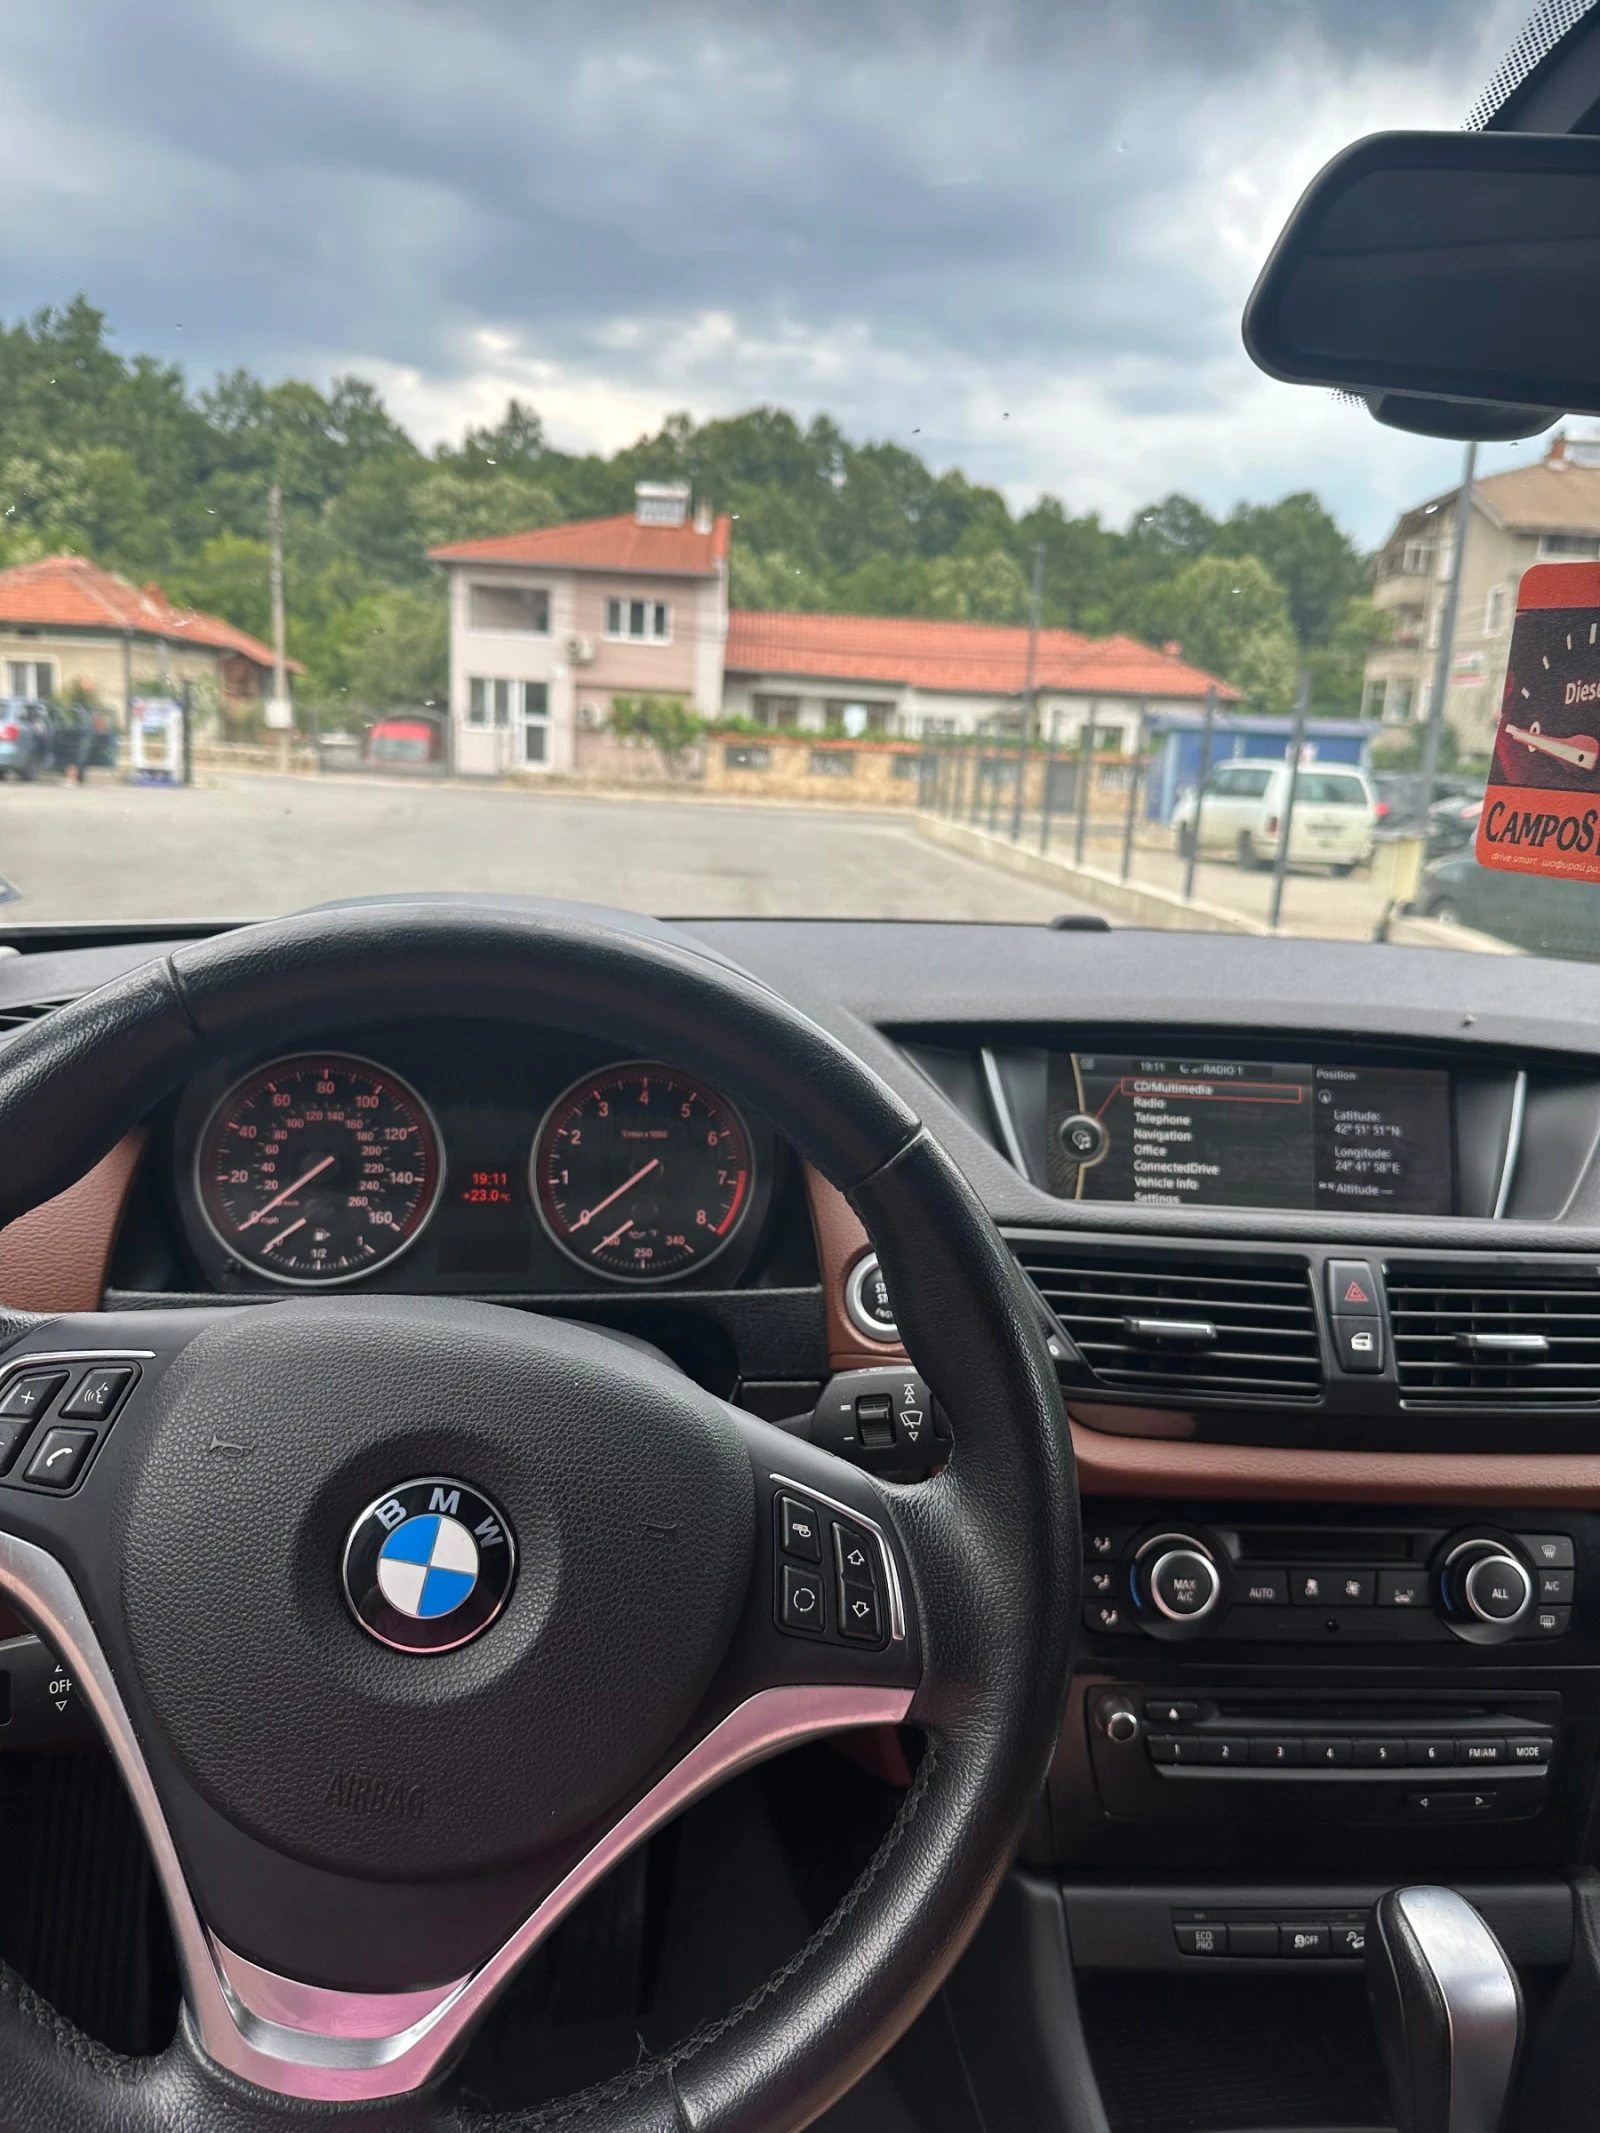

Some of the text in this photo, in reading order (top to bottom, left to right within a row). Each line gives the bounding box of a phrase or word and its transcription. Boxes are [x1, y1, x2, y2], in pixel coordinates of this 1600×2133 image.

[1486, 801, 1600, 856] CAMPOS
[1491, 852, 1537, 864] drive smart
[1140, 1061, 1165, 1072] 19:11
[1203, 1065, 1235, 1075] RADIO
[1316, 1069, 1356, 1080] Position
[316, 1081, 335, 1094] 80
[1133, 1080, 1213, 1096] CD/Multimedia
[273, 1094, 291, 1107] 60
[356, 1096, 379, 1108] 100
[640, 1091, 649, 1105] 4
[1133, 1097, 1166, 1109] Radio
[599, 1102, 609, 1117] 3
[681, 1104, 691, 1117] 5
[1333, 1109, 1381, 1122] Latitude:
[305, 1111, 323, 1121] 120
[327, 1111, 345, 1121] 140
[1134, 1112, 1192, 1127] Telephone
[286, 1118, 304, 1129] 100
[345, 1119, 363, 1129] 160
[238, 1126, 257, 1138] 40
[273, 1129, 288, 1140] 80
[356, 1131, 374, 1142] 180
[384, 1127, 408, 1140] 120
[571, 1130, 581, 1145] 2
[1133, 1127, 1192, 1143] Navigation
[707, 1131, 718, 1146] 6
[265, 1144, 279, 1155] 60
[362, 1145, 382, 1156] 200
[1133, 1143, 1167, 1157] Office
[261, 1162, 275, 1173] 40
[364, 1163, 384, 1174] 220
[1133, 1159, 1220, 1176] ConnectedDrive
[230, 1170, 248, 1183] 20
[390, 1172, 413, 1185] 140
[472, 1172, 507, 1185] 19:11
[561, 1170, 569, 1184] 1
[717, 1170, 727, 1185] 7
[1134, 1175, 1199, 1190] Vehicle Info
[263, 1179, 279, 1191] 20
[359, 1180, 380, 1191] 240
[348, 1196, 368, 1208] 260
[1133, 1192, 1181, 1204] Settings
[369, 1210, 393, 1225] 160
[580, 1210, 590, 1225] 0
[696, 1209, 707, 1225] 8
[665, 1235, 685, 1246] 340
[311, 1248, 327, 1258] 1/2
[634, 1248, 653, 1258] 250
[375, 1487, 504, 1548] BMW
[1173, 1579, 1196, 1590] MAX
[1544, 1580, 1560, 1592] A/C
[1177, 1591, 1194, 1602] A/C
[1249, 1587, 1275, 1599] AUTO
[1491, 1587, 1509, 1599] ALL
[1174, 1743, 1180, 1756] 1
[1222, 1745, 1230, 1758] 2
[1276, 1746, 1284, 1759] 3
[1326, 1747, 1334, 1760] 4
[1379, 1747, 1387, 1759] 5
[1428, 1747, 1435, 1759] 6
[1468, 1747, 1496, 1758] FM/AM
[1516, 1746, 1540, 1757] MODE
[325, 1770, 425, 1819] AIRBAG
[1195, 1931, 1213, 1941] ECO
[1304, 1936, 1319, 1946] OFF
[1196, 1941, 1213, 1951] PRO
